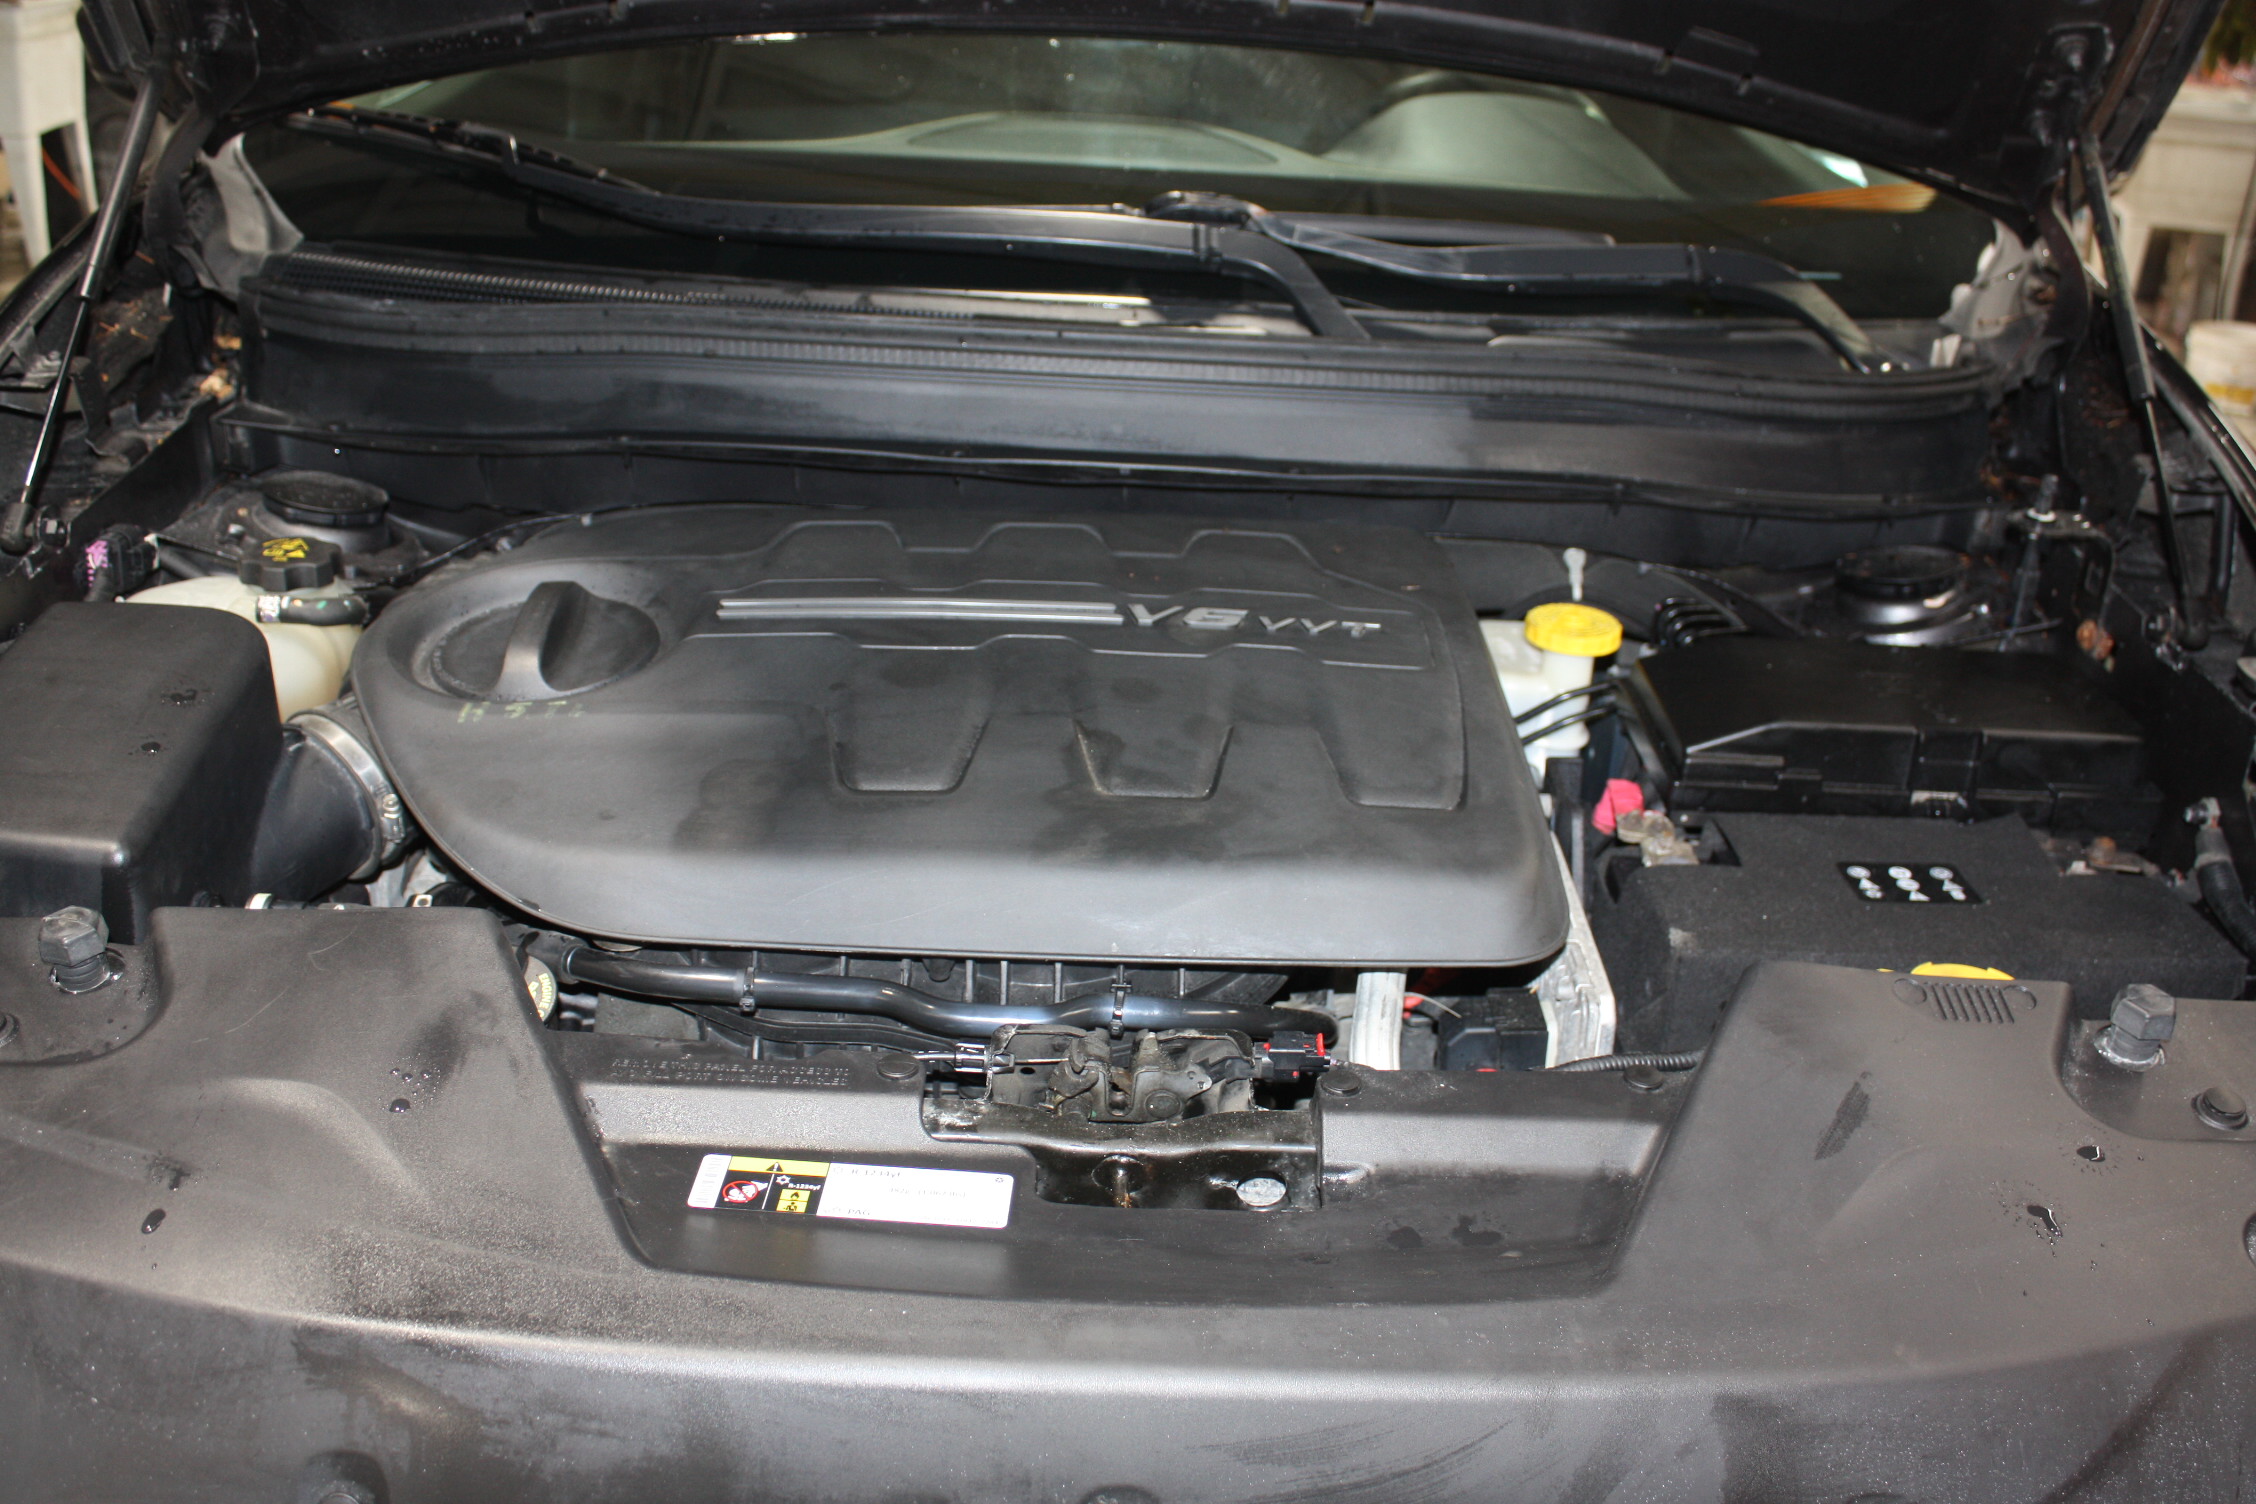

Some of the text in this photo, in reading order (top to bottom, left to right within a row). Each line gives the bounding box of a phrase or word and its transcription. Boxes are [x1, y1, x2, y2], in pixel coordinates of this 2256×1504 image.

[1127, 603, 1382, 638] V6 VVT
[538, 973, 552, 1010] ENGINE
[612, 1058, 668, 1069] REMOVE
[704, 1062, 745, 1072] PANEL
[749, 1064, 777, 1073] FOR
[779, 1066, 831, 1075] ACCESS
[674, 1071, 712, 1080] PORT
[782, 1076, 849, 1086] VEHICLES
